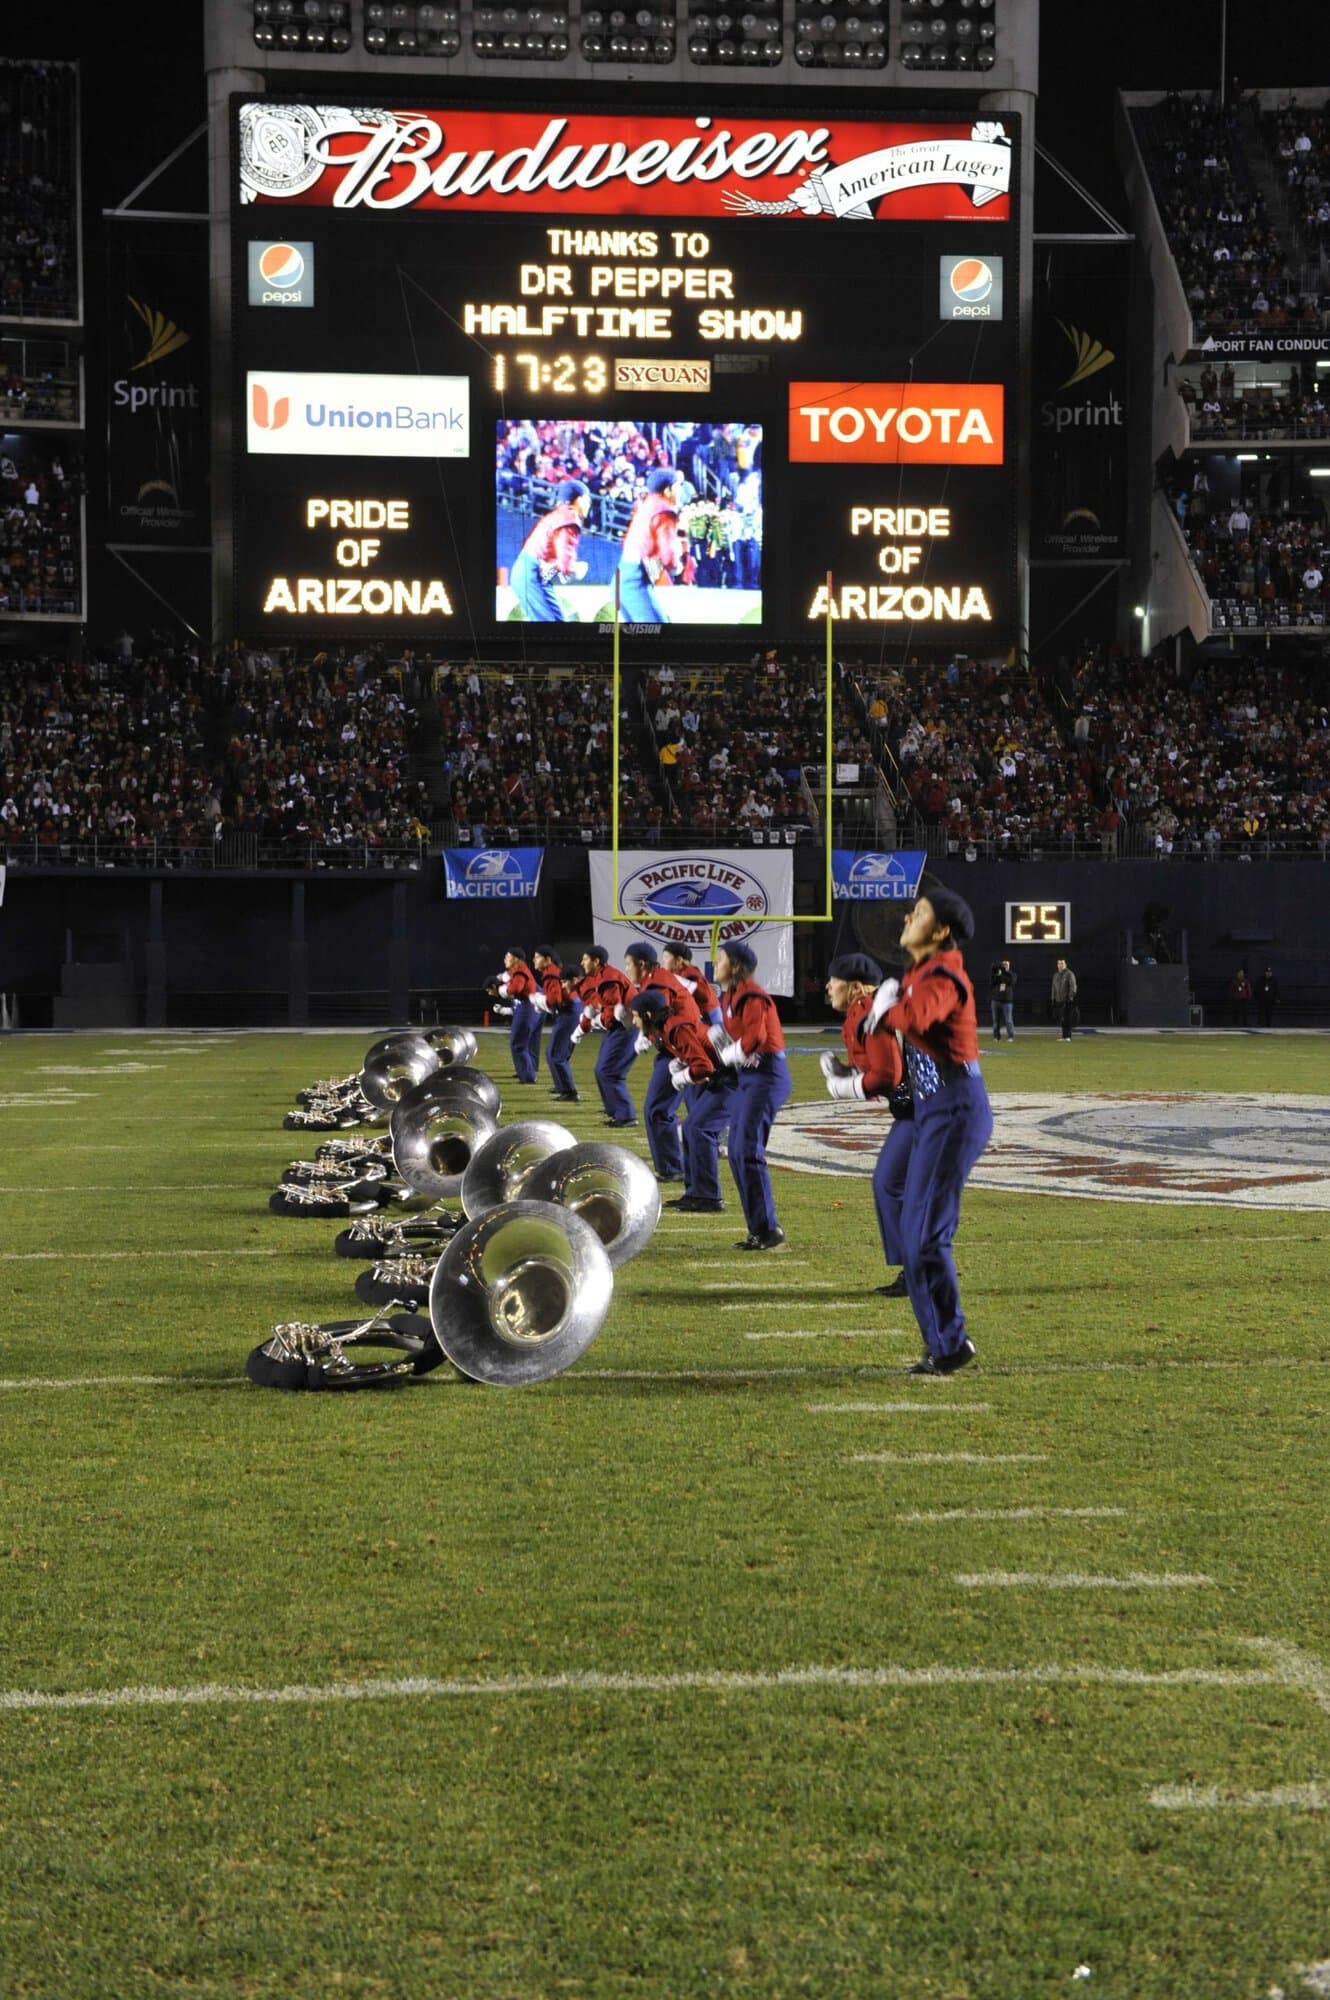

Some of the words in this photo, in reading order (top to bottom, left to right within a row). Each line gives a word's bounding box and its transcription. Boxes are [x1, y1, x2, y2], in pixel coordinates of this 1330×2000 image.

[310, 117, 830, 210] Budweiser
[838, 160, 936, 202] American
[942, 153, 1004, 178] Lager
[546, 229, 658, 258] THANKS
[671, 231, 710, 259] TO
[262, 289, 303, 305] pepsi
[520, 263, 574, 297] DR
[590, 265, 736, 300] PEPPER
[463, 303, 673, 338] HALFTIME
[698, 308, 803, 342] SHOW
[952, 303, 992, 319] pepsi
[1208, 340, 1246, 352] PORT
[1249, 340, 1274, 351] FAN
[1277, 339, 1330, 351] CONDUC
[493, 353, 608, 394] 17:23
[617, 366, 709, 385] SYCUAN
[113, 379, 200, 413] Sprint
[305, 403, 465, 431] UnionBank
[800, 405, 994, 444] TOYOTA
[1041, 399, 1124, 433] Sprint
[306, 499, 410, 530] PRIDE
[850, 506, 951, 538] PRIDE
[336, 538, 381, 569] OF
[878, 545, 923, 575] OF
[262, 577, 454, 616] ARIZONA
[807, 584, 993, 622] ARIZONA
[510, 880, 535, 897] LIF
[639, 864, 706, 889] PACIFIC
[707, 863, 746, 890] LIFE
[893, 881, 917, 898] LIF
[708, 919, 757, 941] OW
[1016, 905, 1060, 940] 25
